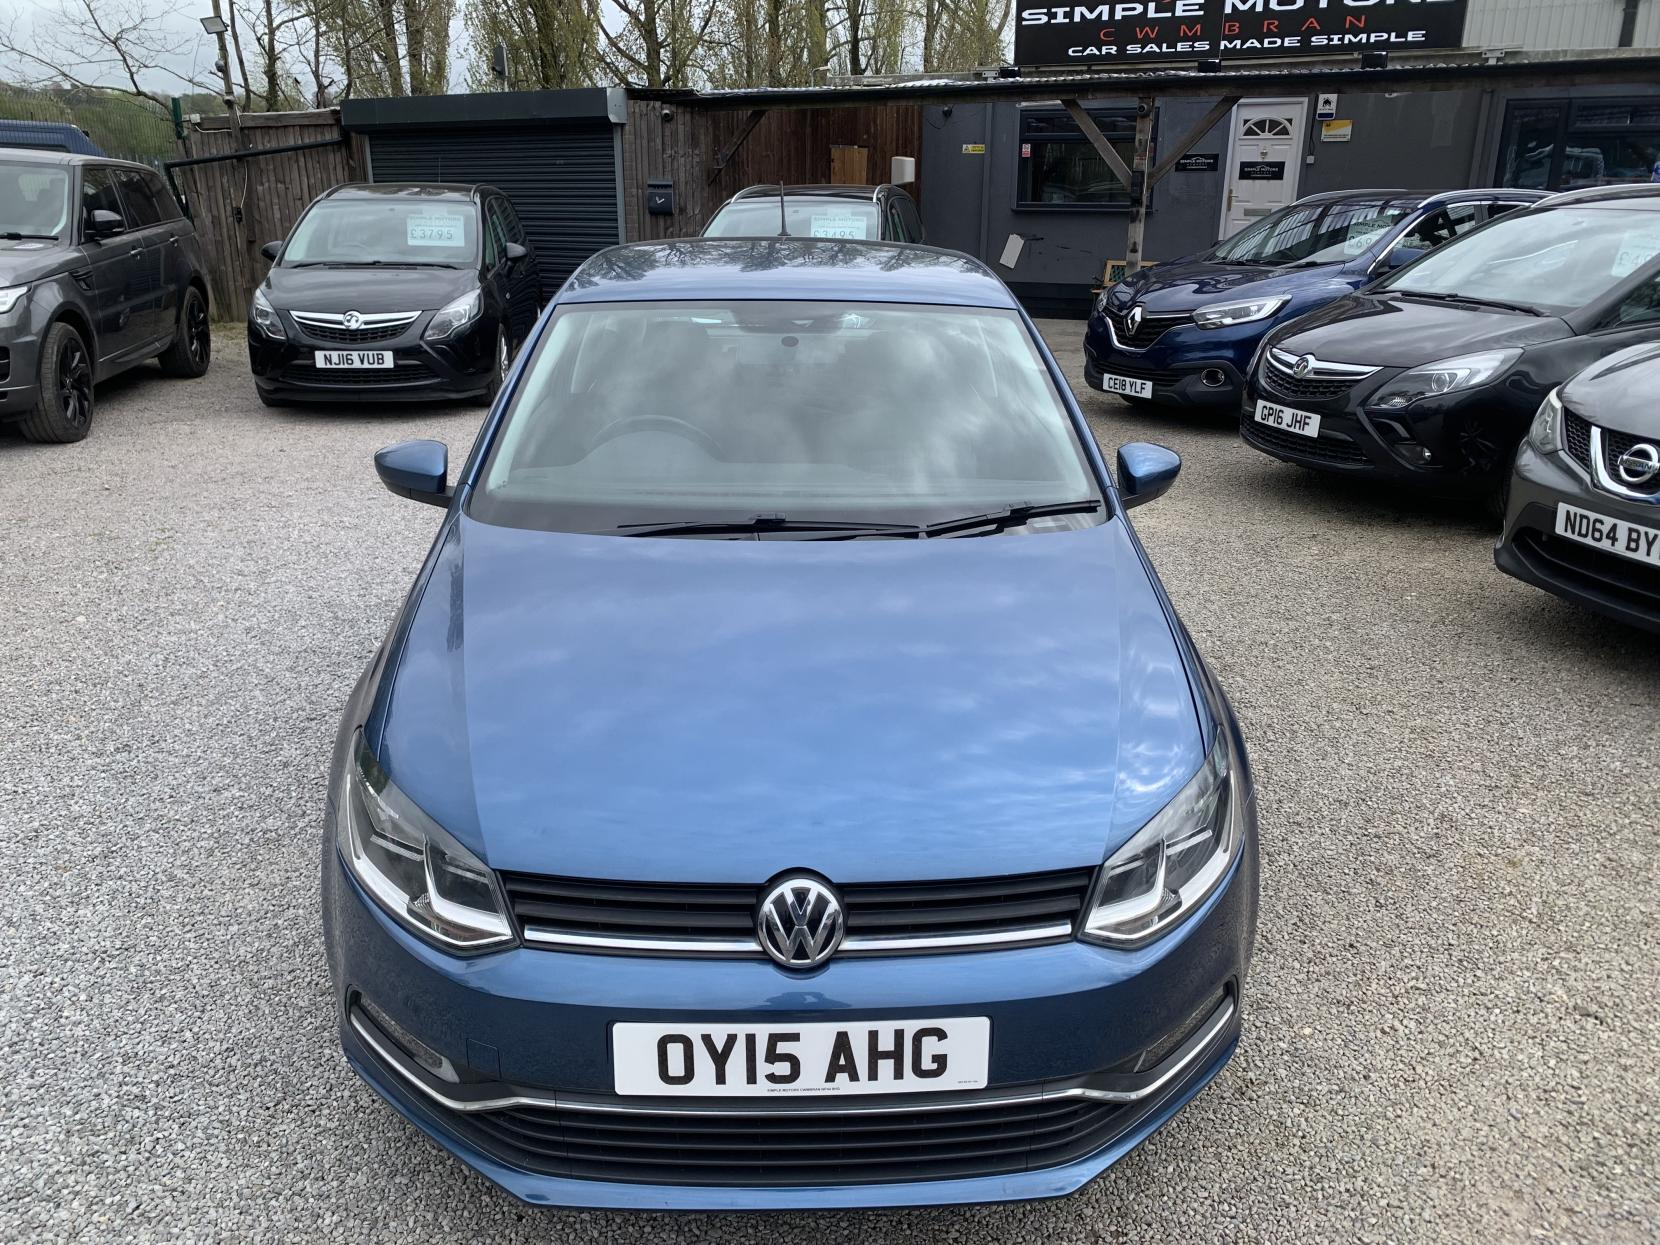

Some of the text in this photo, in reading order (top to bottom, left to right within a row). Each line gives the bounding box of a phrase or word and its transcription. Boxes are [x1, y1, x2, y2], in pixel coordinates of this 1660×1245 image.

[1021, 0, 1204, 25] SIMPLE
[1100, 15, 1366, 40] CWMBRAN
[1068, 30, 1426, 56] CAR SALES MADE SIMPLE
[410, 229, 453, 240] £3795
[323, 353, 385, 366] NJ16 VUB
[1108, 376, 1147, 395] CE18 YLF
[1260, 405, 1312, 432] GP16 JHF
[1564, 509, 1660, 561] ND64 BY
[656, 1027, 949, 1086] OY15 AHG
